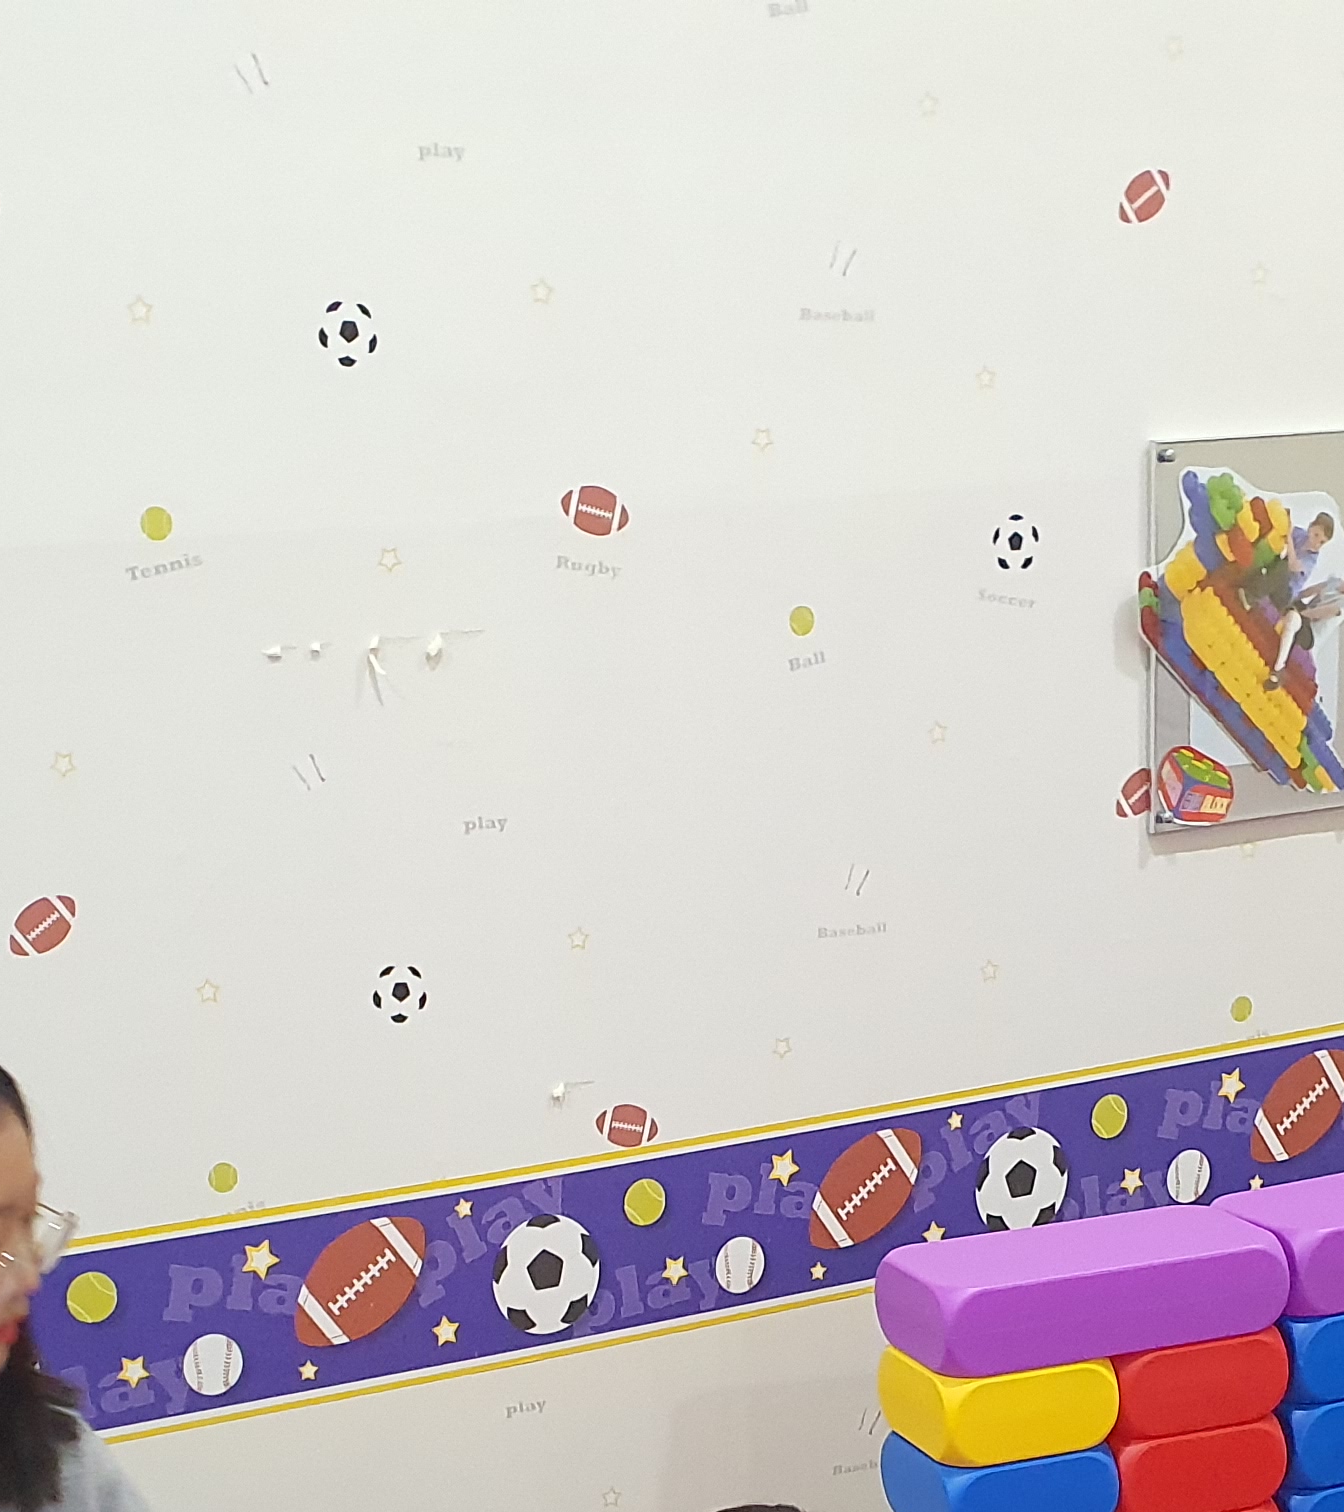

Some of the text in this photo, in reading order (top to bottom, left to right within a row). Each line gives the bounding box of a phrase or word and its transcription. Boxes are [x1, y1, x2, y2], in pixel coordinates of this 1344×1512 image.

[418, 142, 465, 162] play
[125, 554, 203, 581] Tennis
[556, 555, 623, 580] Rugby
[978, 588, 1036, 609] Soccer
[788, 651, 825, 672] Ball
[463, 816, 507, 835] play
[817, 922, 886, 939] Baseball
[1157, 1080, 1261, 1140] pla
[702, 1162, 820, 1227] pla
[163, 1254, 306, 1323] pla
[507, 1400, 546, 1419] play
